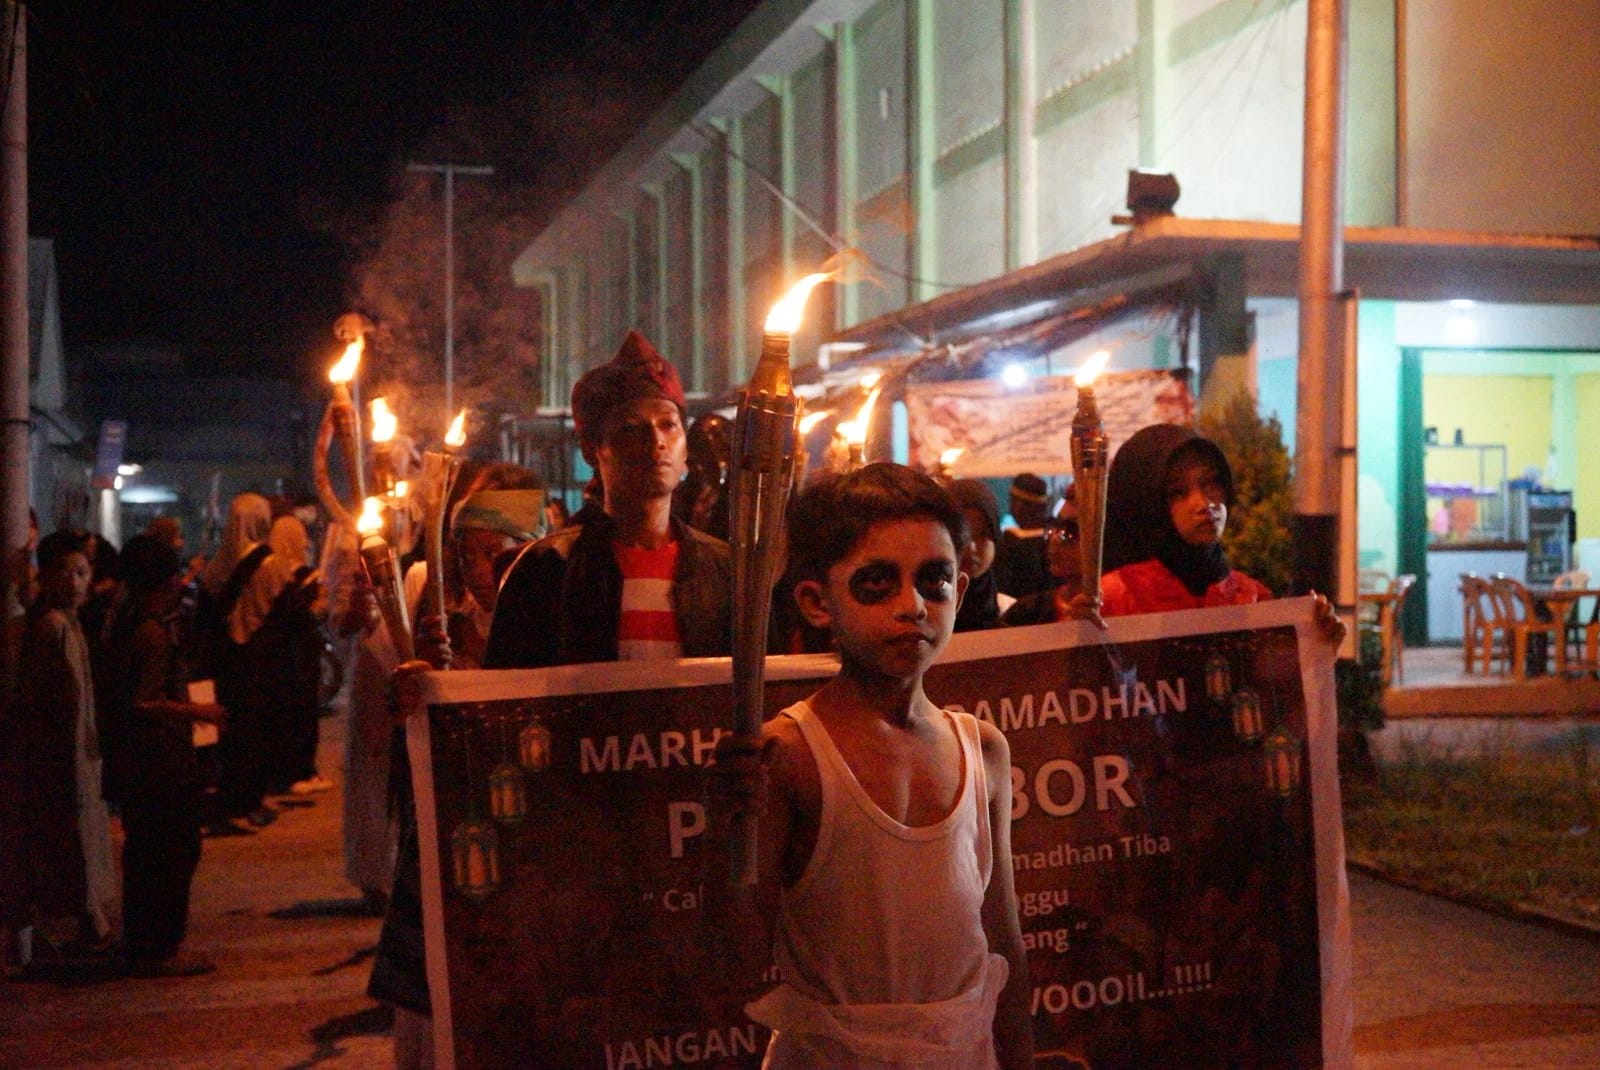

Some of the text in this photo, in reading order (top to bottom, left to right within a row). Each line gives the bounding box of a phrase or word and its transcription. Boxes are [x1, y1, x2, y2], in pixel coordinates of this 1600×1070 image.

[943, 677, 1188, 732] AMADHAN
[1120, 834, 1171, 859] Tiba
[1015, 888, 1069, 917] ggu
